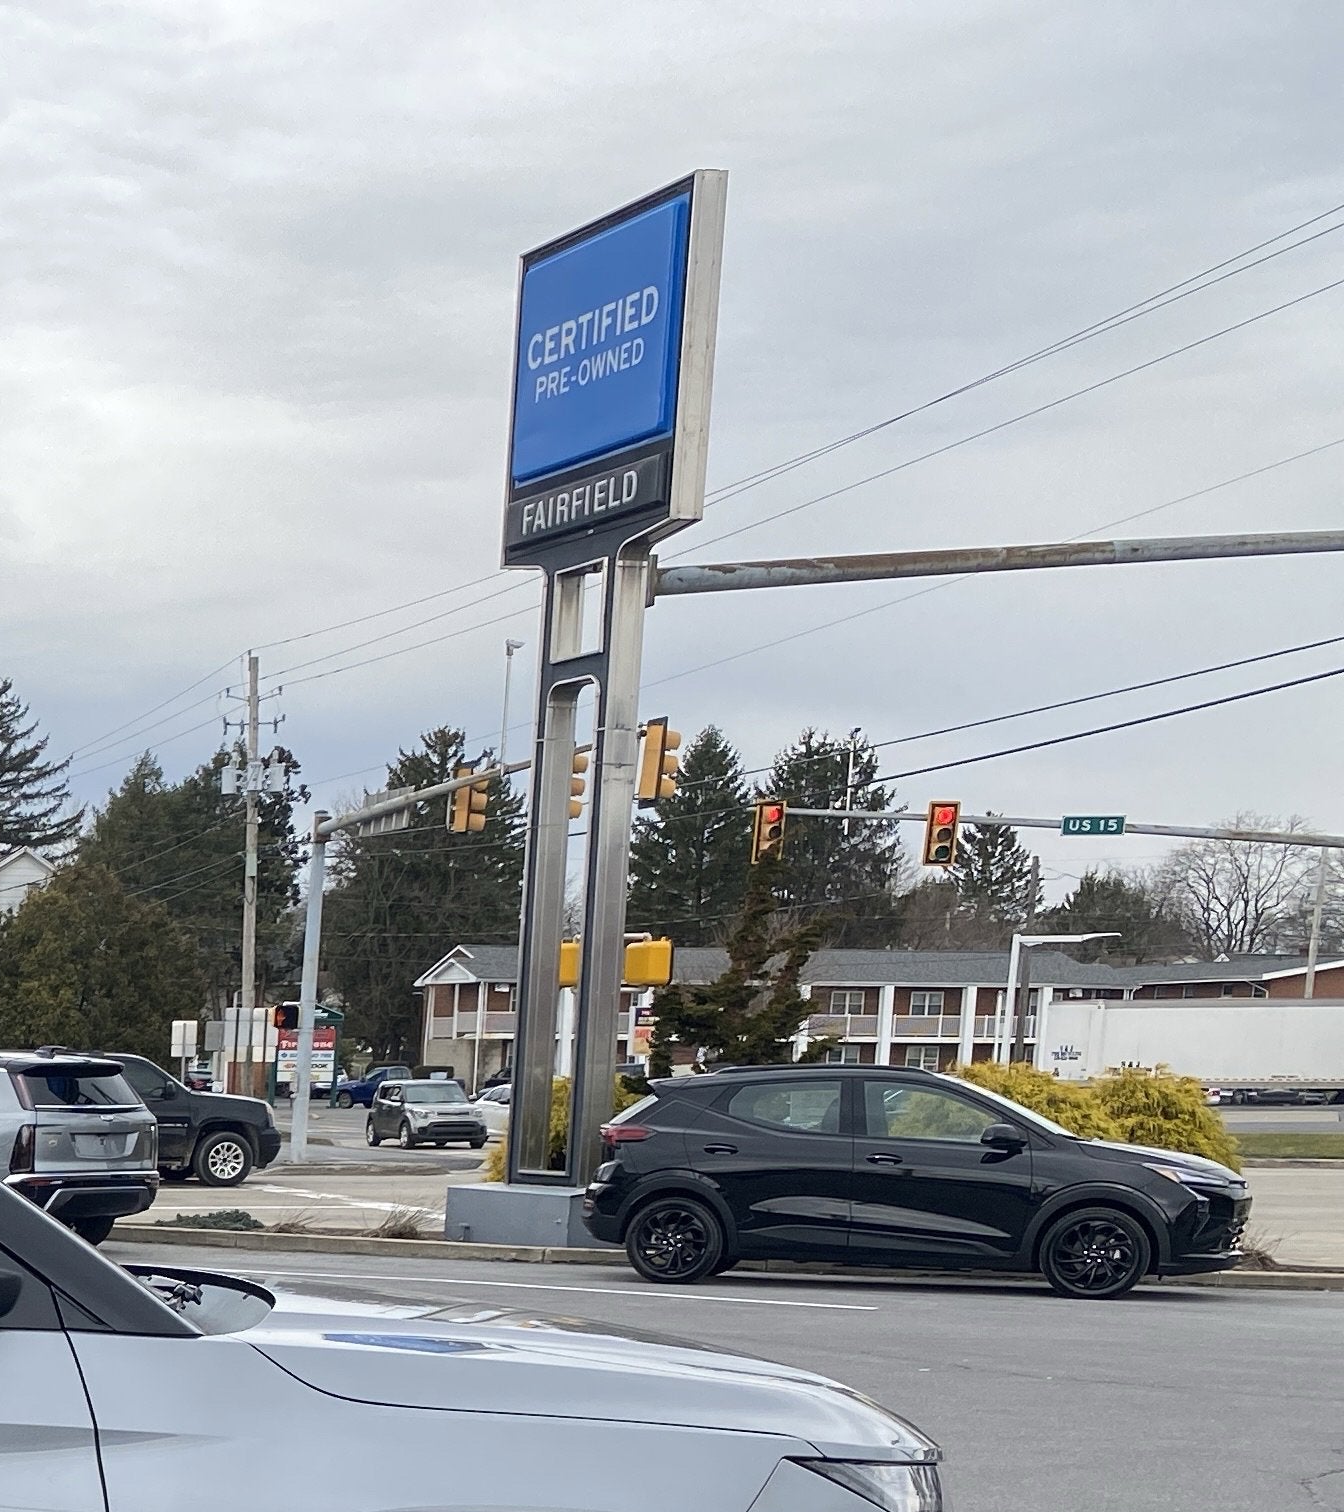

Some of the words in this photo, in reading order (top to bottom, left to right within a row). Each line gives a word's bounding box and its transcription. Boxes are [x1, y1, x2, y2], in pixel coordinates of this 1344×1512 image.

[527, 285, 659, 370] CERTIFIED
[535, 337, 645, 403] PRE-OWNED
[522, 470, 638, 536] FAIRFIELD
[1069, 819, 1092, 832] US
[1099, 819, 1118, 832] 15
